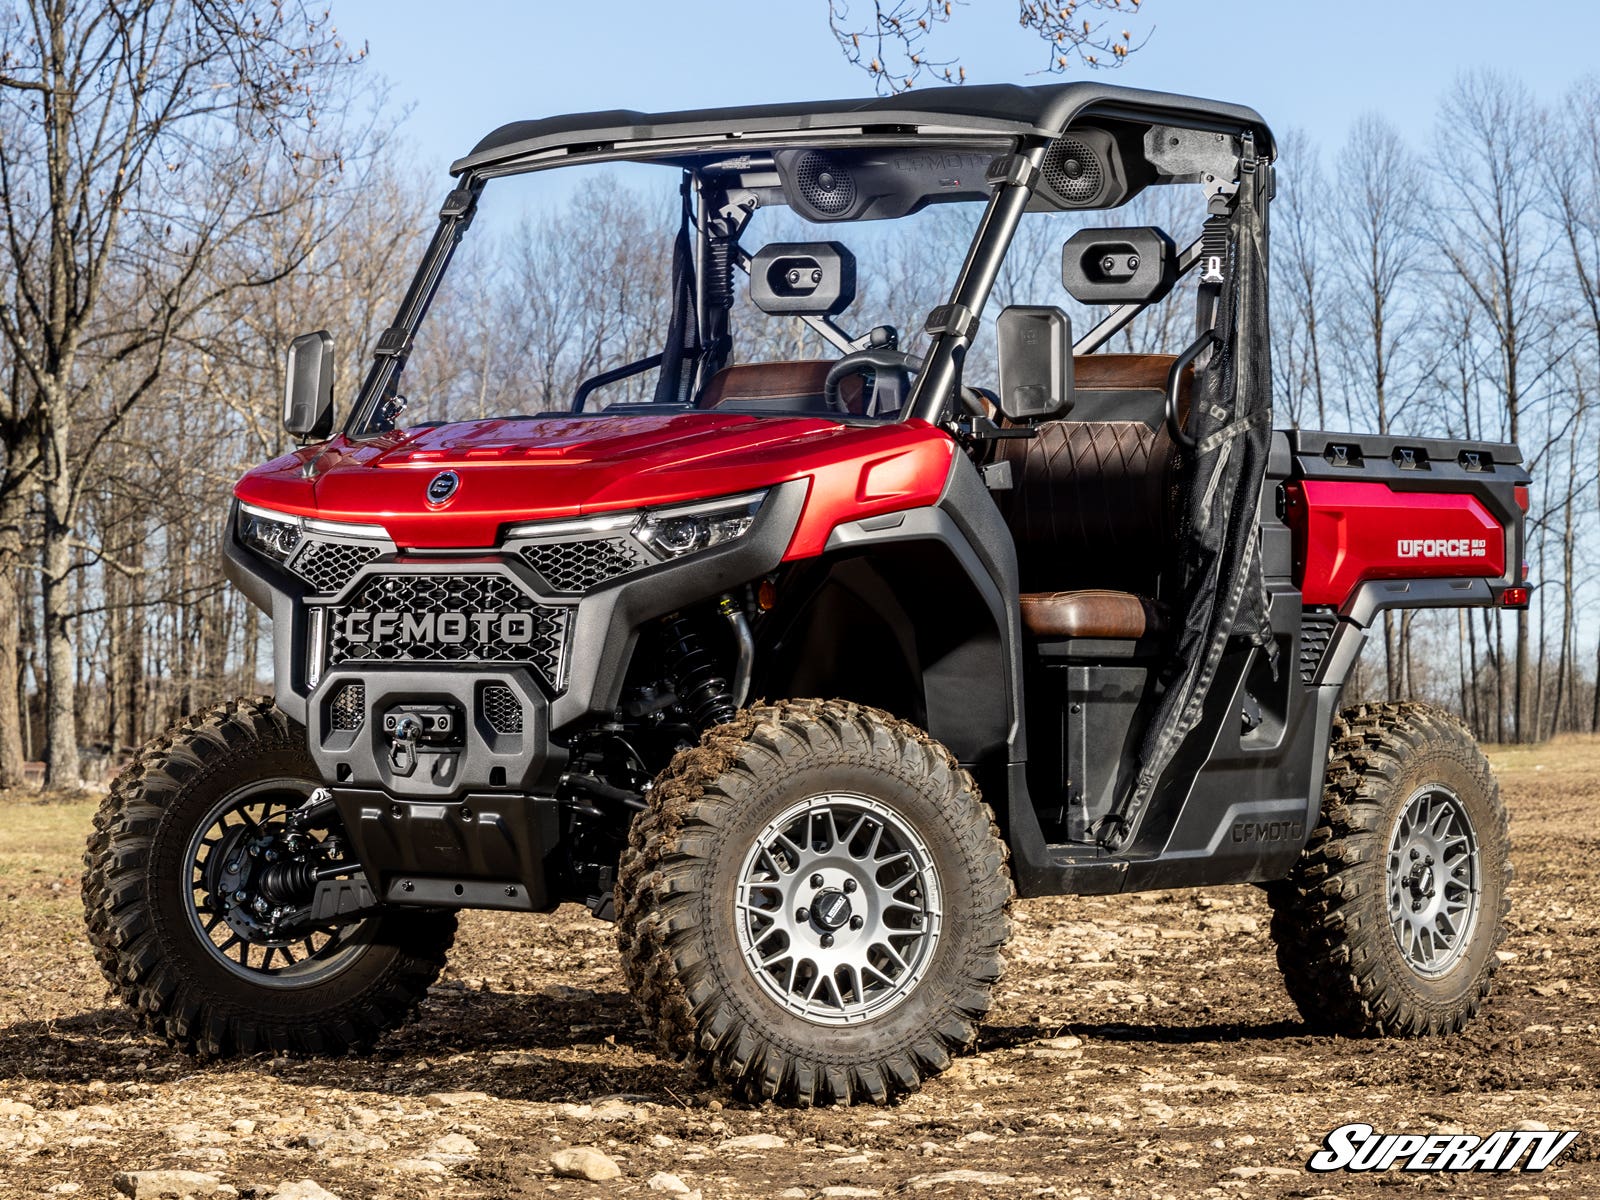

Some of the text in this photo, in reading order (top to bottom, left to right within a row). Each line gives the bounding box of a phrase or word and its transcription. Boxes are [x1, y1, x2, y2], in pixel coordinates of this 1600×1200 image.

[1397, 540, 1470, 557] UFORCE
[346, 612, 532, 643] CFMOTO
[1232, 822, 1303, 842] CFMOTO
